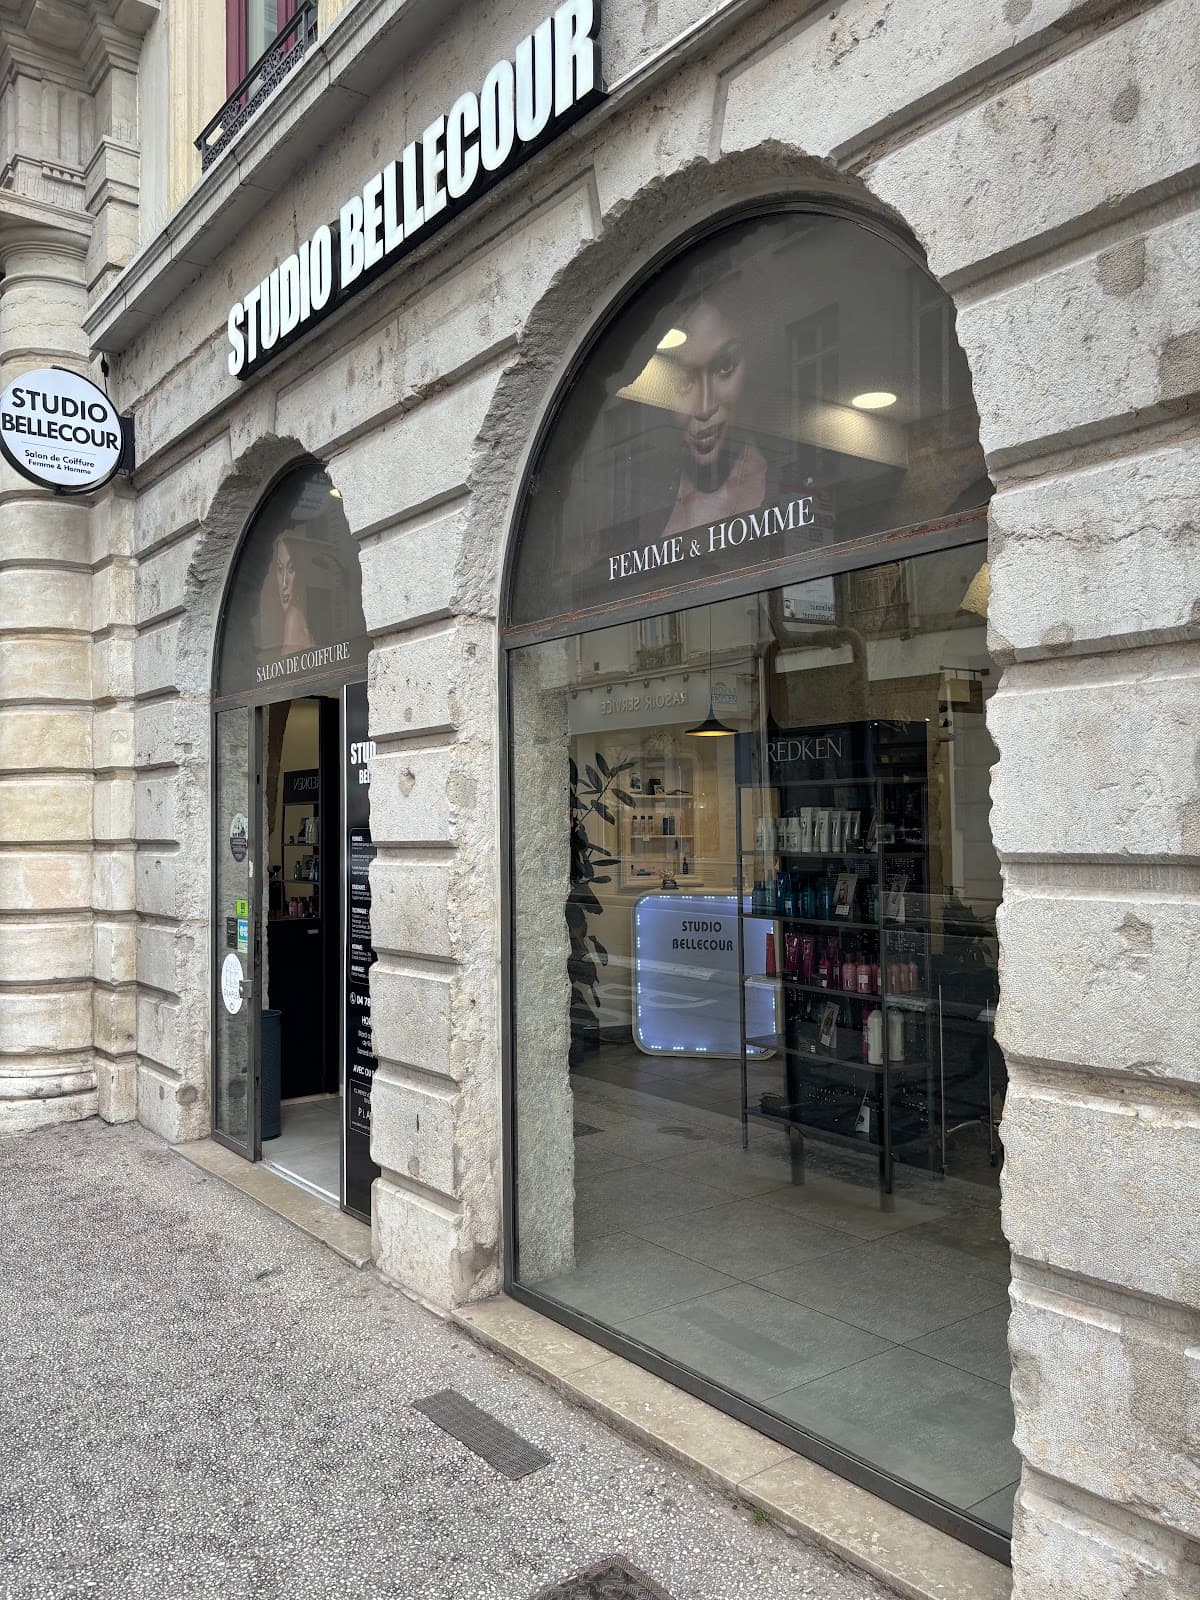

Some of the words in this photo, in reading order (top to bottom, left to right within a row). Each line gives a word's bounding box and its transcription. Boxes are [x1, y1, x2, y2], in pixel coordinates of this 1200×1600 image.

[227, 225, 333, 377] STUDIO
[339, 0, 596, 291] BELLECOUR
[12, 387, 108, 423] STUDIO
[1, 412, 119, 451] BELLECOUR
[24, 449, 48, 460] Salon
[50, 453, 61, 462] de
[62, 455, 95, 468] Coiffure
[28, 458, 55, 469] Femme
[64, 464, 92, 475] Homme
[608, 536, 685, 581] FEMME
[689, 539, 701, 558] &
[707, 496, 815, 553] HOMME
[256, 660, 285, 683] SALON
[286, 655, 300, 675] DE
[300, 641, 350, 671] COIFFURE
[765, 736, 842, 763] REDKEN
[681, 920, 722, 933] STUDIO
[672, 938, 734, 952] BELLECOUR
